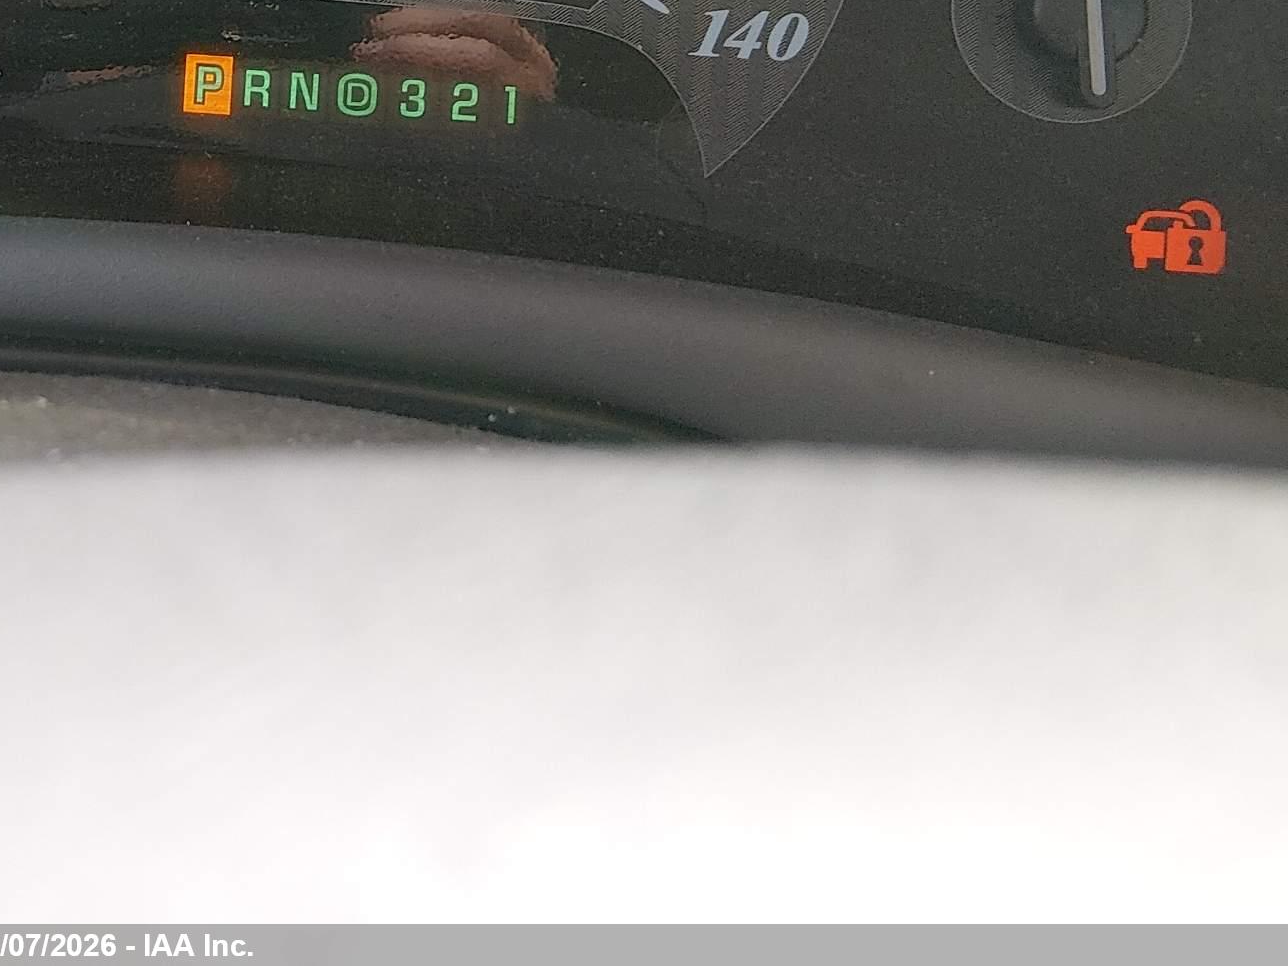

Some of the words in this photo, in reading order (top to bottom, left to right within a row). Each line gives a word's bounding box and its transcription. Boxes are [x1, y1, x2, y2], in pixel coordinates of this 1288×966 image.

[689, 9, 810, 61] 140
[197, 64, 224, 104] P
[243, 69, 271, 108] R
[289, 72, 320, 111] N
[400, 79, 426, 117] 3
[451, 83, 479, 122] 2
[504, 86, 518, 124] 1
